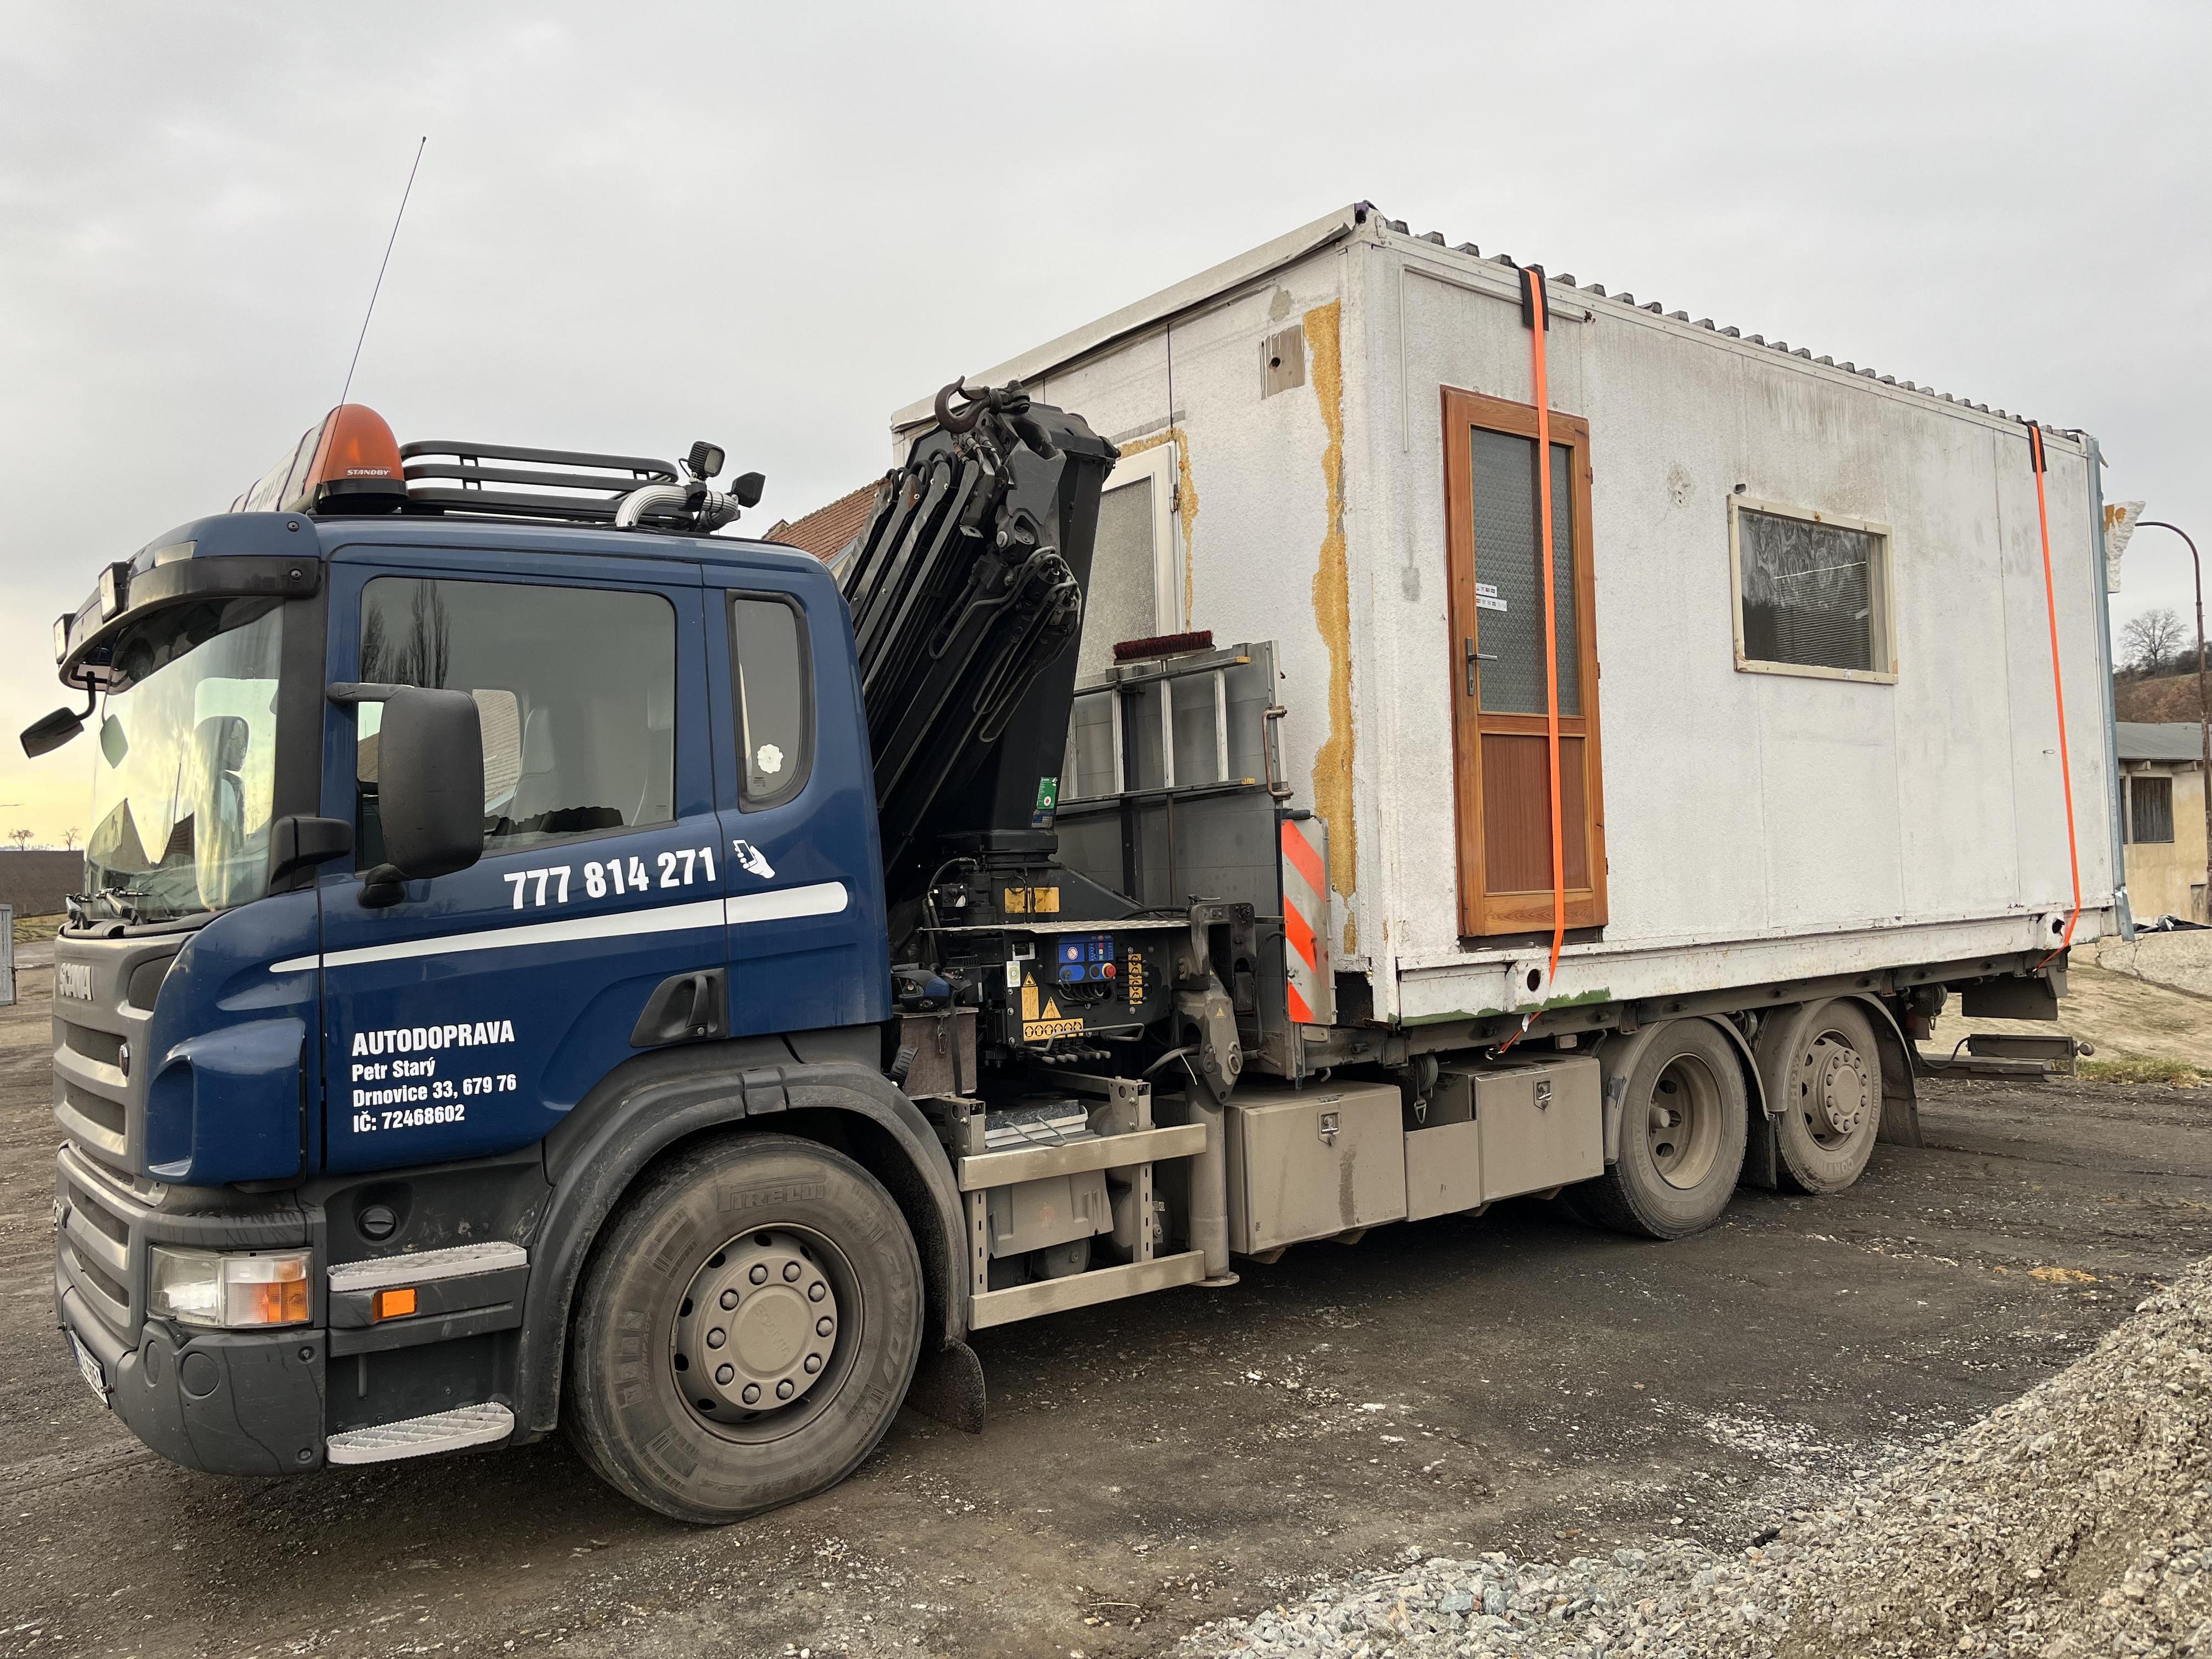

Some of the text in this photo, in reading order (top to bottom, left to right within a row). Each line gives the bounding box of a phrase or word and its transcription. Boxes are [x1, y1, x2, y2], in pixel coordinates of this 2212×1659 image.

[504, 847, 716, 910] 777 814 271
[352, 1020, 515, 1057] AUTODOPRAVA
[352, 1057, 436, 1082] Petr Starý
[353, 1073, 517, 1108] Drnovice 33, 679 76
[353, 1104, 465, 1133] IČ: 72468602
[717, 1173, 826, 1213] PIRELLI
